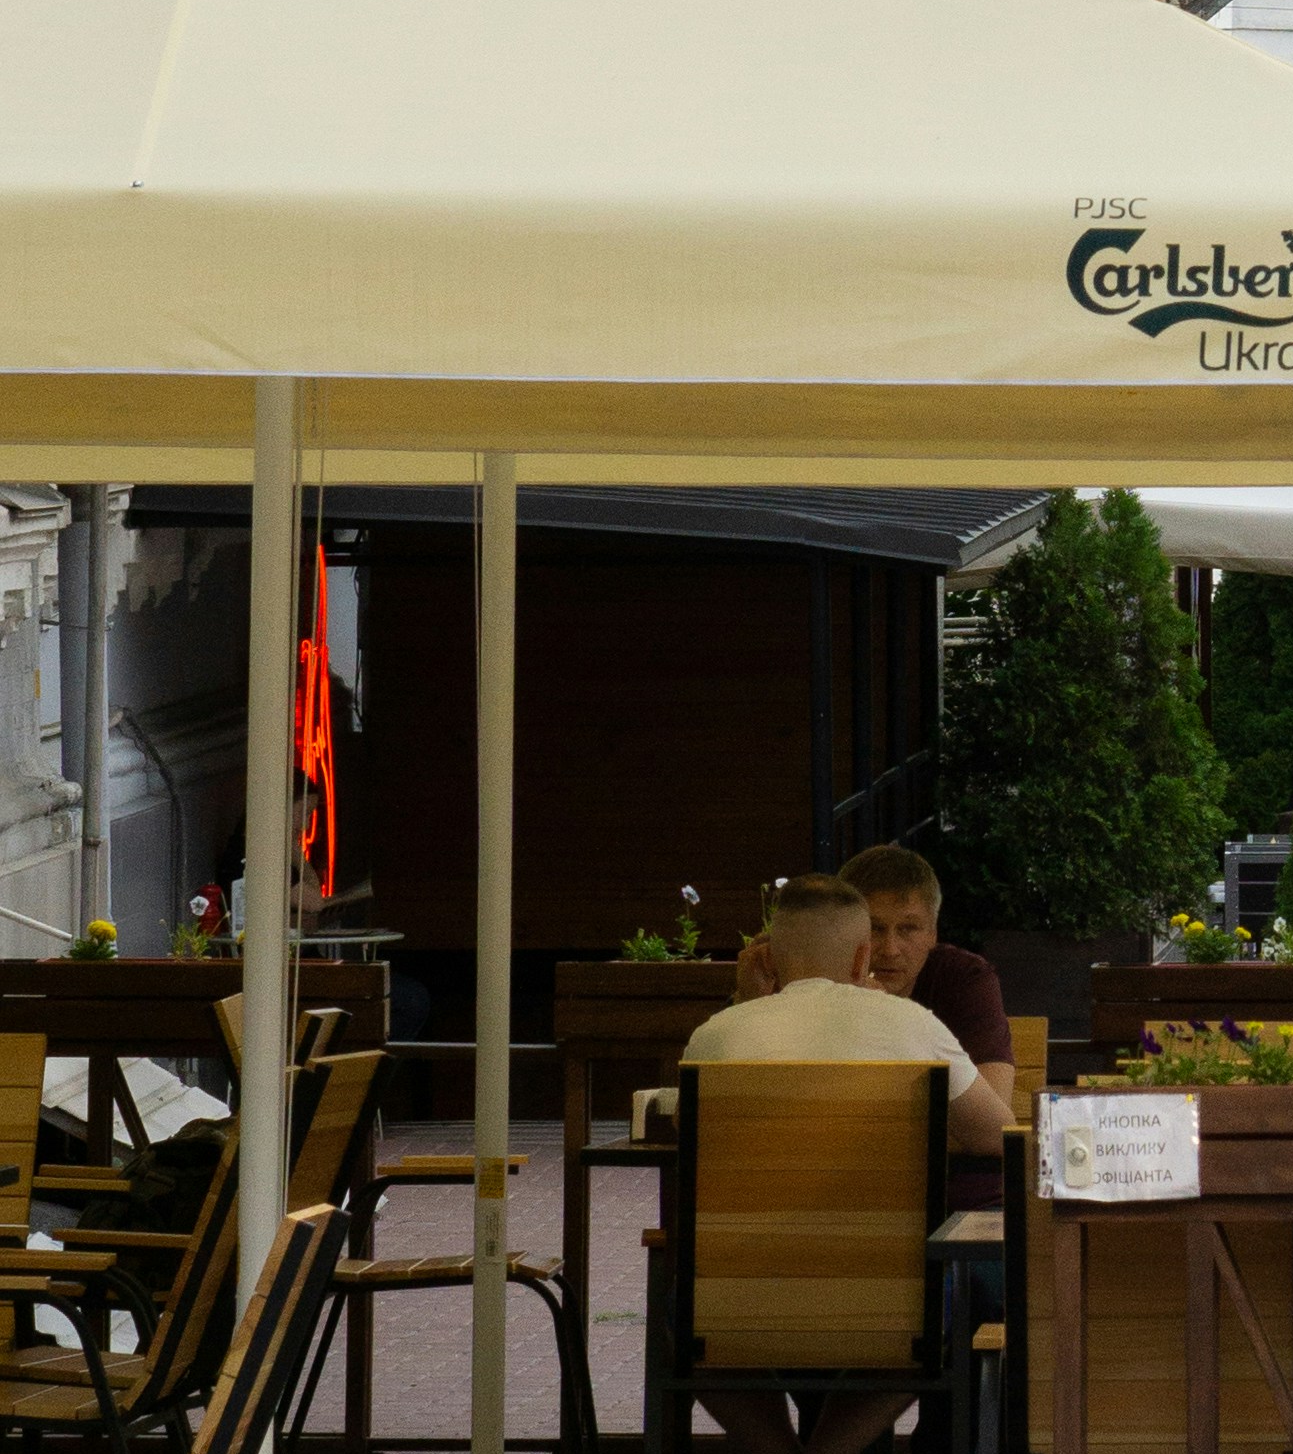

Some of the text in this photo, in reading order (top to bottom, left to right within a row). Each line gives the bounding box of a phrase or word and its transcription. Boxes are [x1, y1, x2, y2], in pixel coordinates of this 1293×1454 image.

[1073, 197, 1148, 220] PJSC
[1098, 1114, 1162, 1130] КНОПКА
[1095, 1141, 1167, 1157] ВИКЛИКУ
[1093, 1168, 1173, 1186] ОФІЦІАНТА
